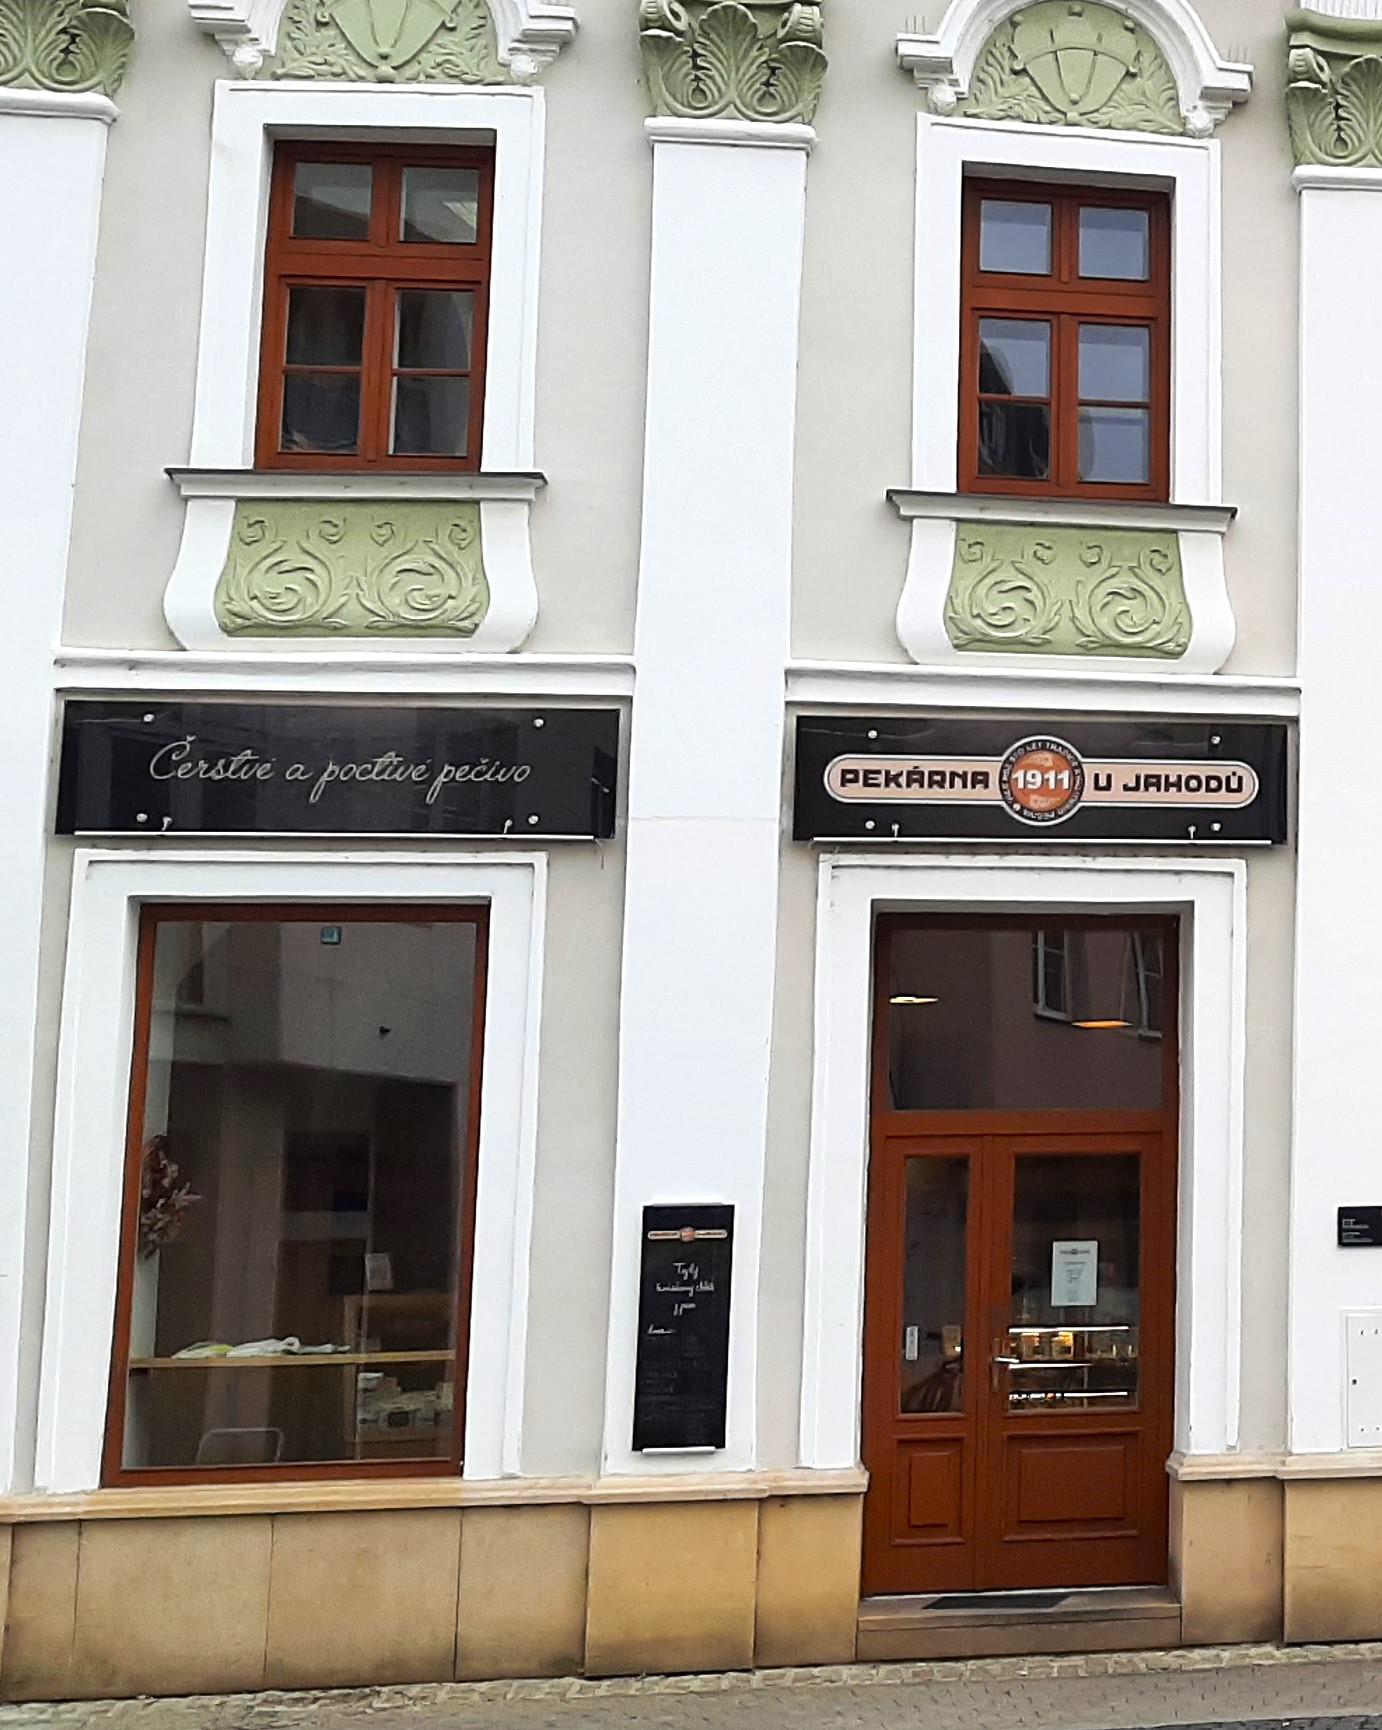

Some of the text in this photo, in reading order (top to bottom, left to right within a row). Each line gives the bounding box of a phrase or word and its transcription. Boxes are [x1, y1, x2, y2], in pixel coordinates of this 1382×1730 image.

[150, 735, 531, 805] Čerstvé a poctivé pečivo
[839, 765, 990, 790] PEKÁRNA
[1012, 769, 1070, 790] 1911
[1093, 772, 1113, 792] U
[1122, 771, 1244, 794] JAHODŮ
